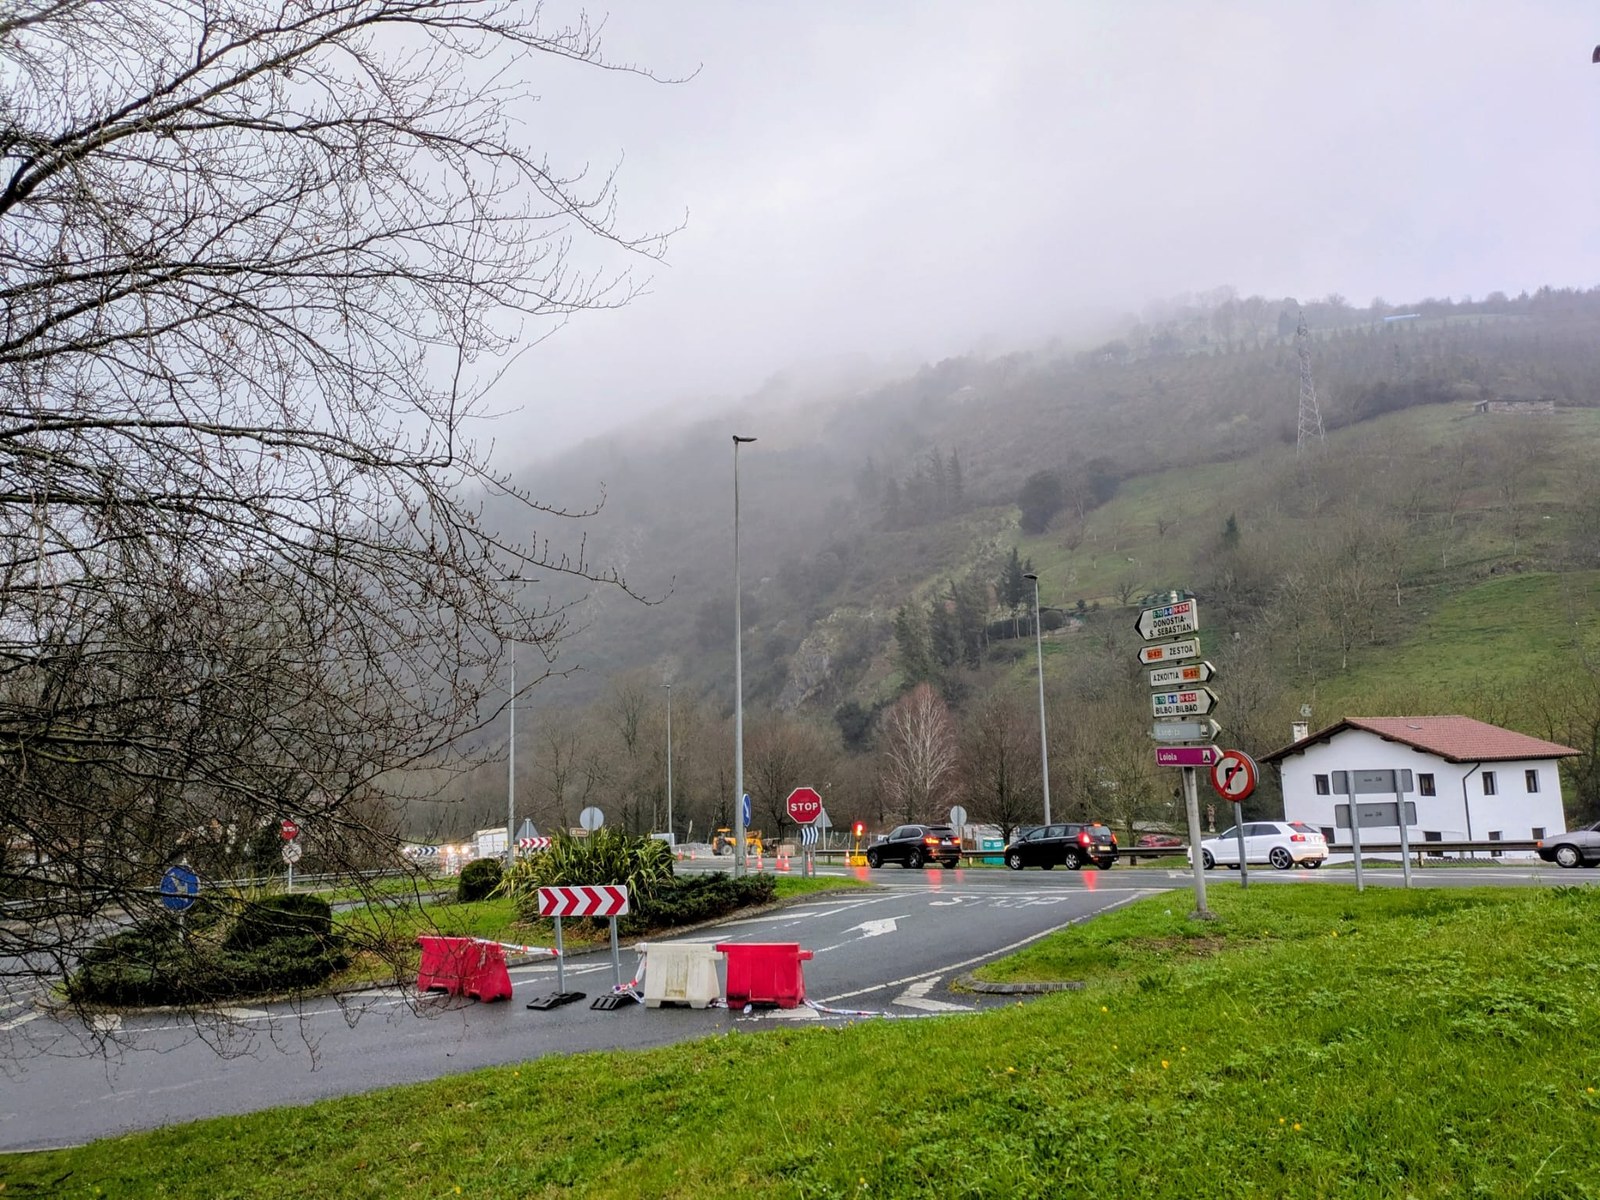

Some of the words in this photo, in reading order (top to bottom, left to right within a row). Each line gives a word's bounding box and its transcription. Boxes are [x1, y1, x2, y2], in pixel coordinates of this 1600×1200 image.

[1169, 645, 1194, 656] ZESTOA
[1153, 671, 1180, 682] AZKOITIA
[1159, 752, 1178, 761] Loiola
[790, 802, 818, 812] STOP
